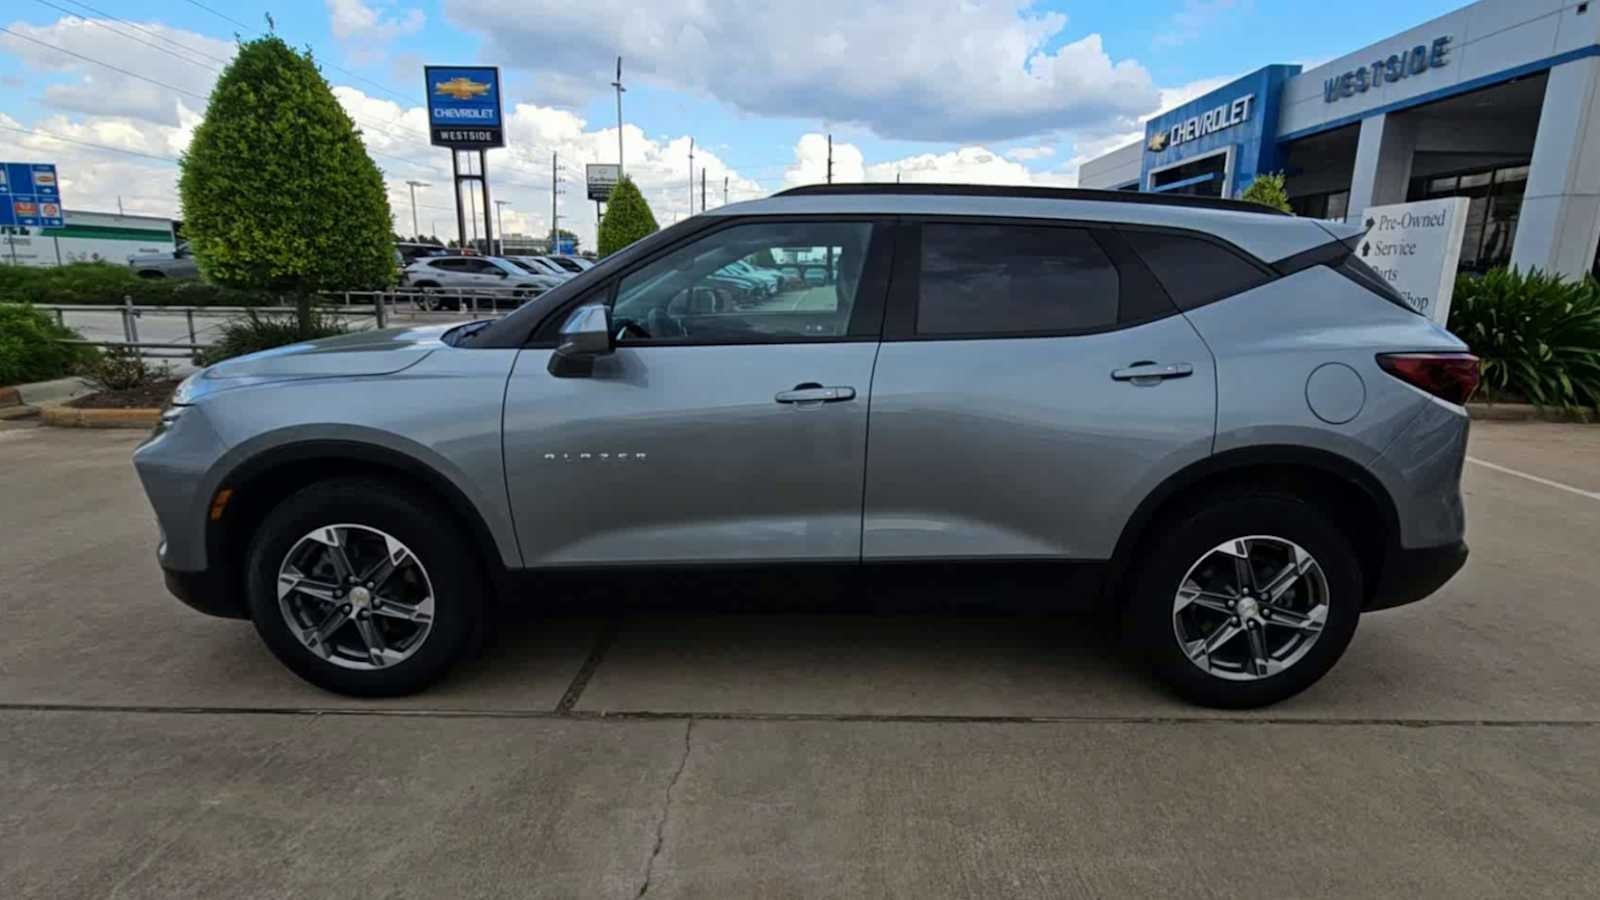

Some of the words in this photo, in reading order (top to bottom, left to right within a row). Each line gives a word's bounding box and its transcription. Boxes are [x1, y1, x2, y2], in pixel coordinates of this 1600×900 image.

[1323, 36, 1452, 103] WESTSIDE
[434, 108, 494, 118] CHEVROLET
[1170, 94, 1254, 146] CHEVROLET
[441, 131, 492, 141] WESTSIDE
[1378, 210, 1447, 231] Pre-Owned
[1374, 240, 1416, 256] Service
